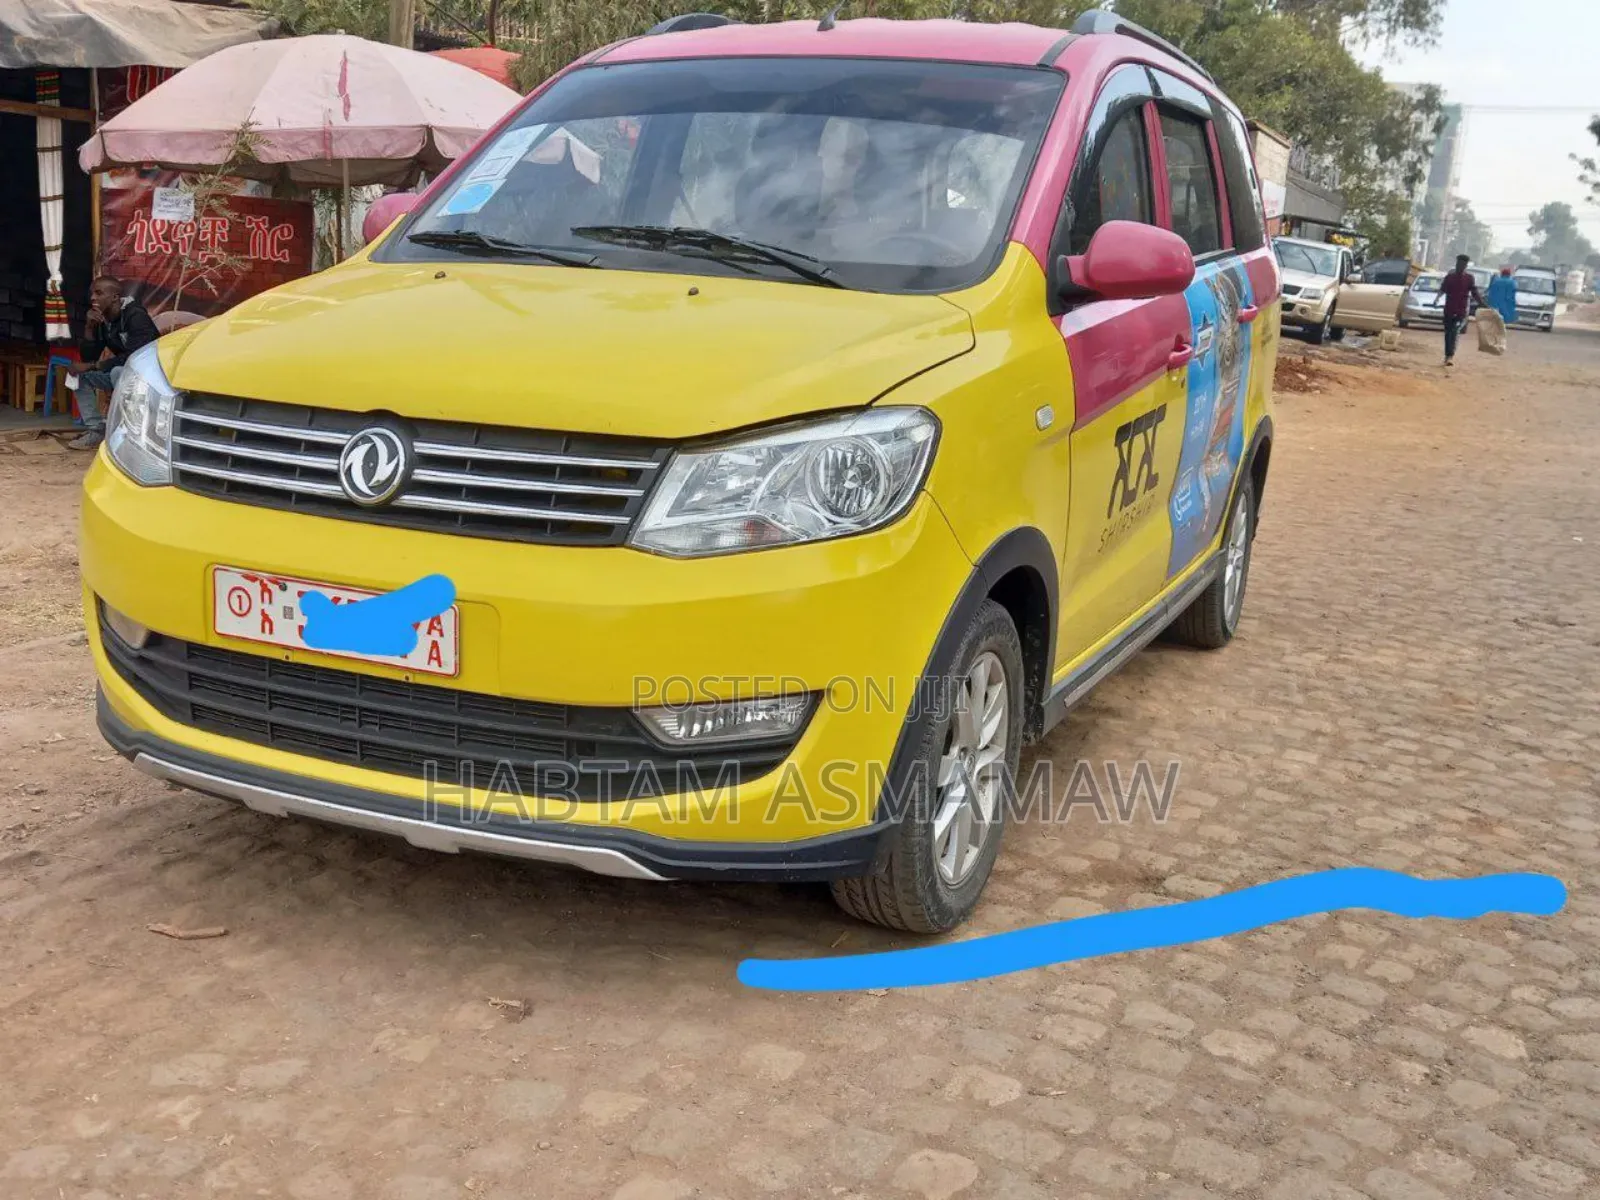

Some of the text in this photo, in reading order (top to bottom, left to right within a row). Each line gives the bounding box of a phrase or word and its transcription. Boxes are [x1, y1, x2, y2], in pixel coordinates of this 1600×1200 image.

[245, 215, 294, 262] ሽሮ
[426, 614, 444, 638] A
[427, 639, 442, 668] A
